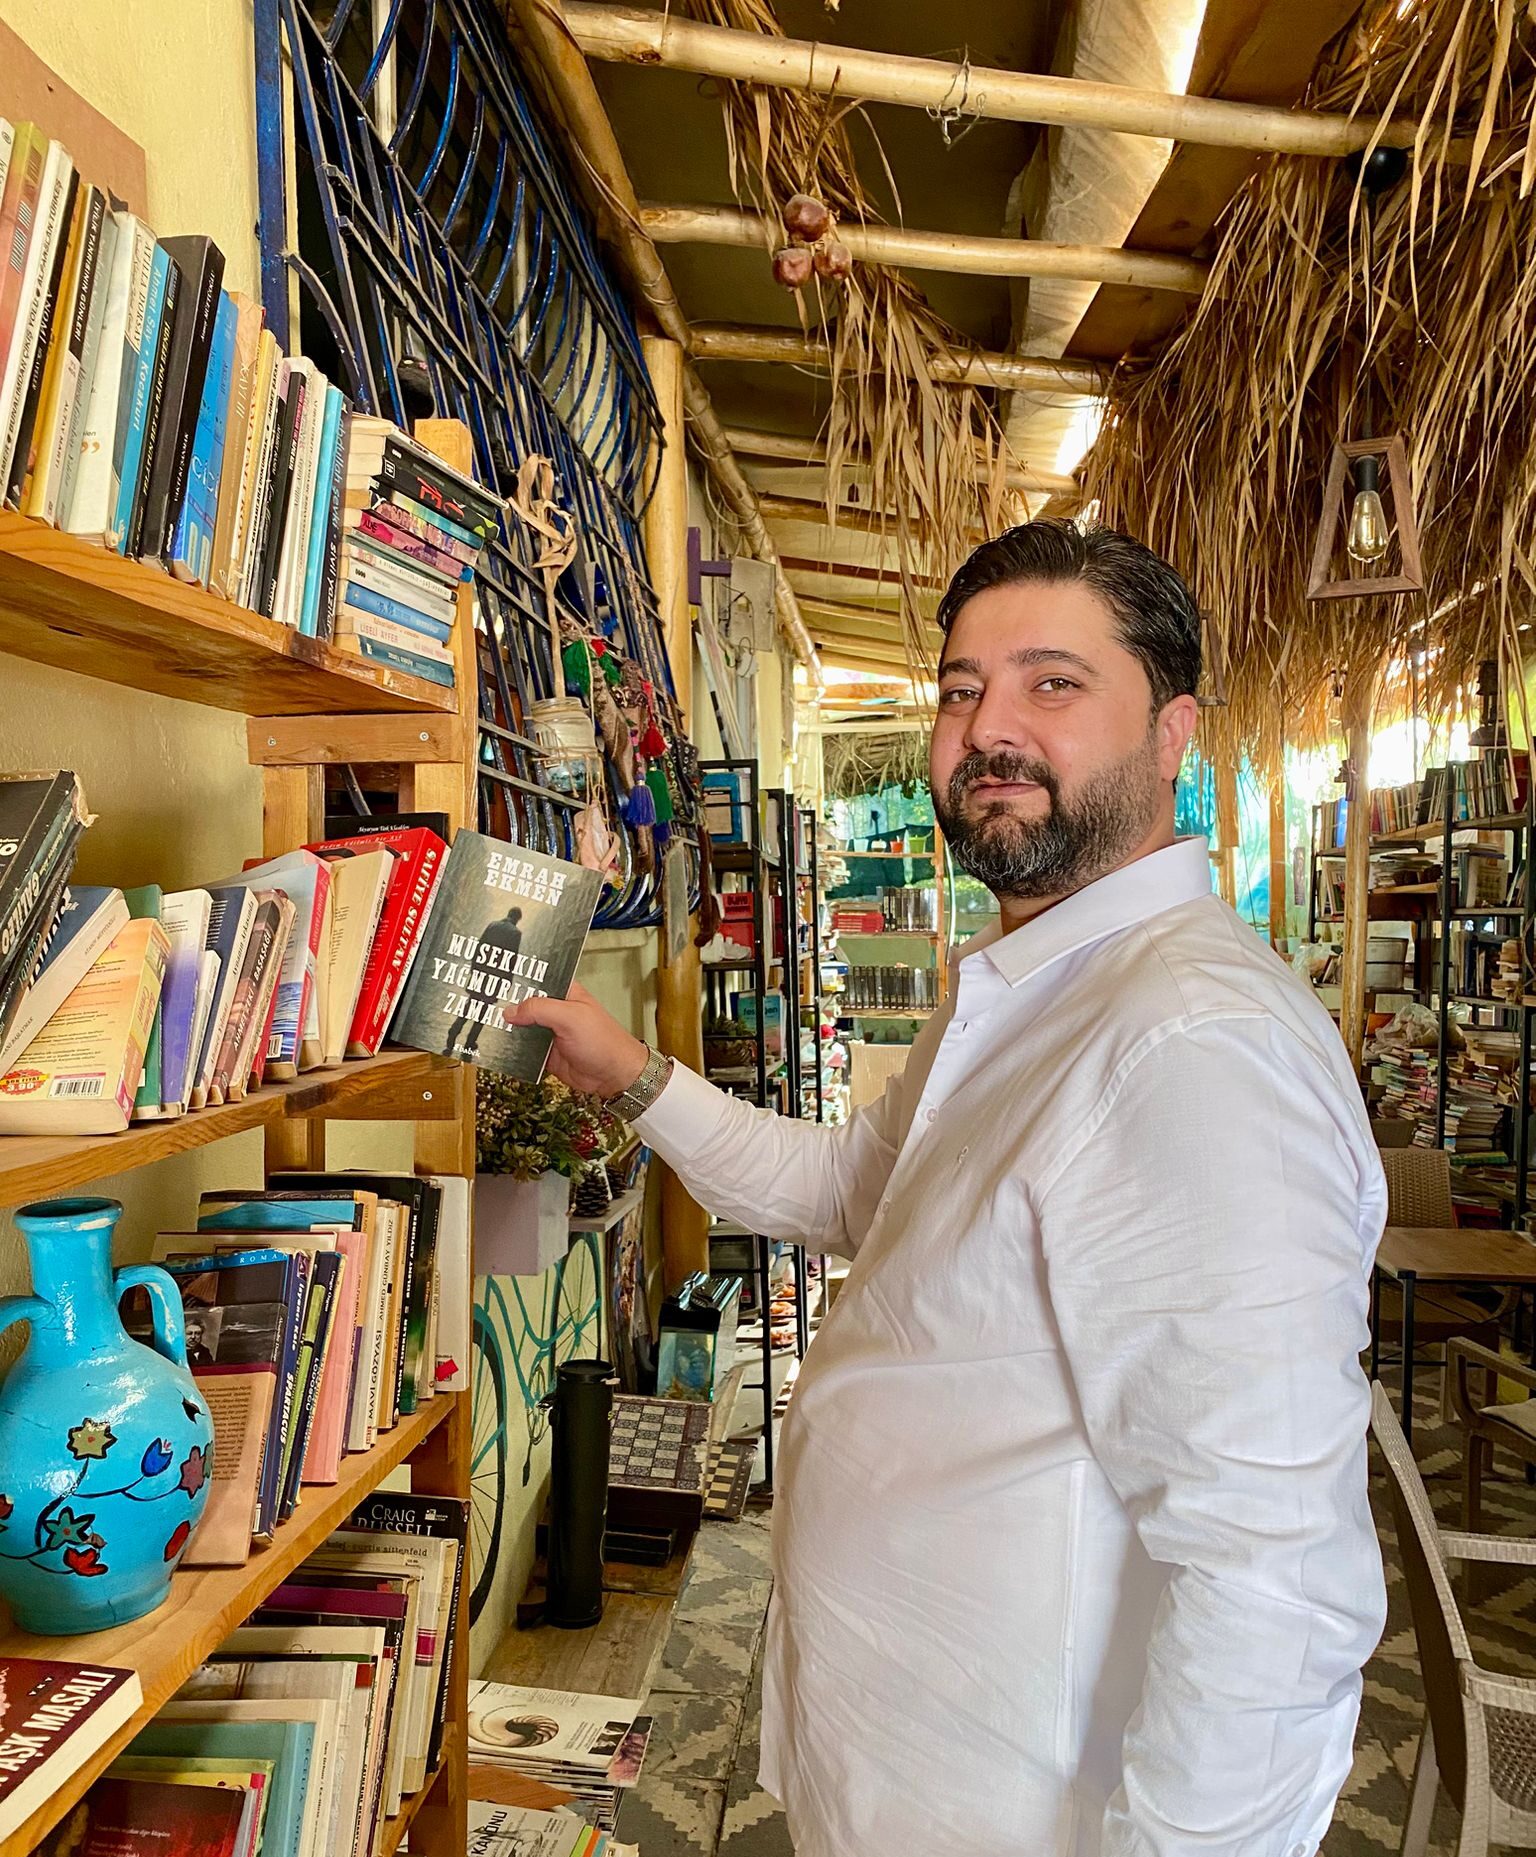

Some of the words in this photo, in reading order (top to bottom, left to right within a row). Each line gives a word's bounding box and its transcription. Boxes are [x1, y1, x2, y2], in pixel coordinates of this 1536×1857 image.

[81, 232, 97, 293] TANRISININ
[8, 358, 27, 432] BUNALIMDAN
[28, 297, 39, 327] YOLU
[35, 224, 54, 287] ALPARSLAN
[48, 178, 63, 221] TÜRKEŞ
[148, 265, 162, 313] Ahmet
[75, 294, 89, 342] GÜNLERİ
[134, 293, 147, 346] DORSAY
[145, 316, 155, 344] Say
[133, 361, 151, 432] Kocakurt
[235, 363, 253, 398] KAYI
[234, 400, 247, 419] III
[333, 418, 346, 483] abdullah
[328, 541, 338, 577] sivil
[412, 847, 437, 906] SAFİYE
[484, 868, 562, 906] EKMEN
[487, 852, 567, 890] EMRAH
[238, 900, 256, 941] Arkasında
[392, 905, 418, 969] SULTAN
[447, 934, 549, 982] MÜSEKKİN
[229, 1012, 250, 1050] AHMET
[242, 989, 256, 1012] ZEKİ
[386, 1218, 394, 1246] YILDIZ
[381, 1249, 391, 1288] GÜNBAY
[379, 1288, 387, 1320] AHMED
[281, 1372, 295, 1446] SPARTACUS
[367, 1386, 376, 1420] MAVİ
[372, 1504, 416, 1522] CRAIG
[353, 1543, 380, 1552] curtis
[383, 1546, 428, 1557] sittenfeld
[455, 1544, 464, 1583] CRAIG
[449, 1585, 460, 1632] RUSSELL
[22, 1671, 116, 1732] MASALI
[0, 1733, 50, 1771] AŞK
